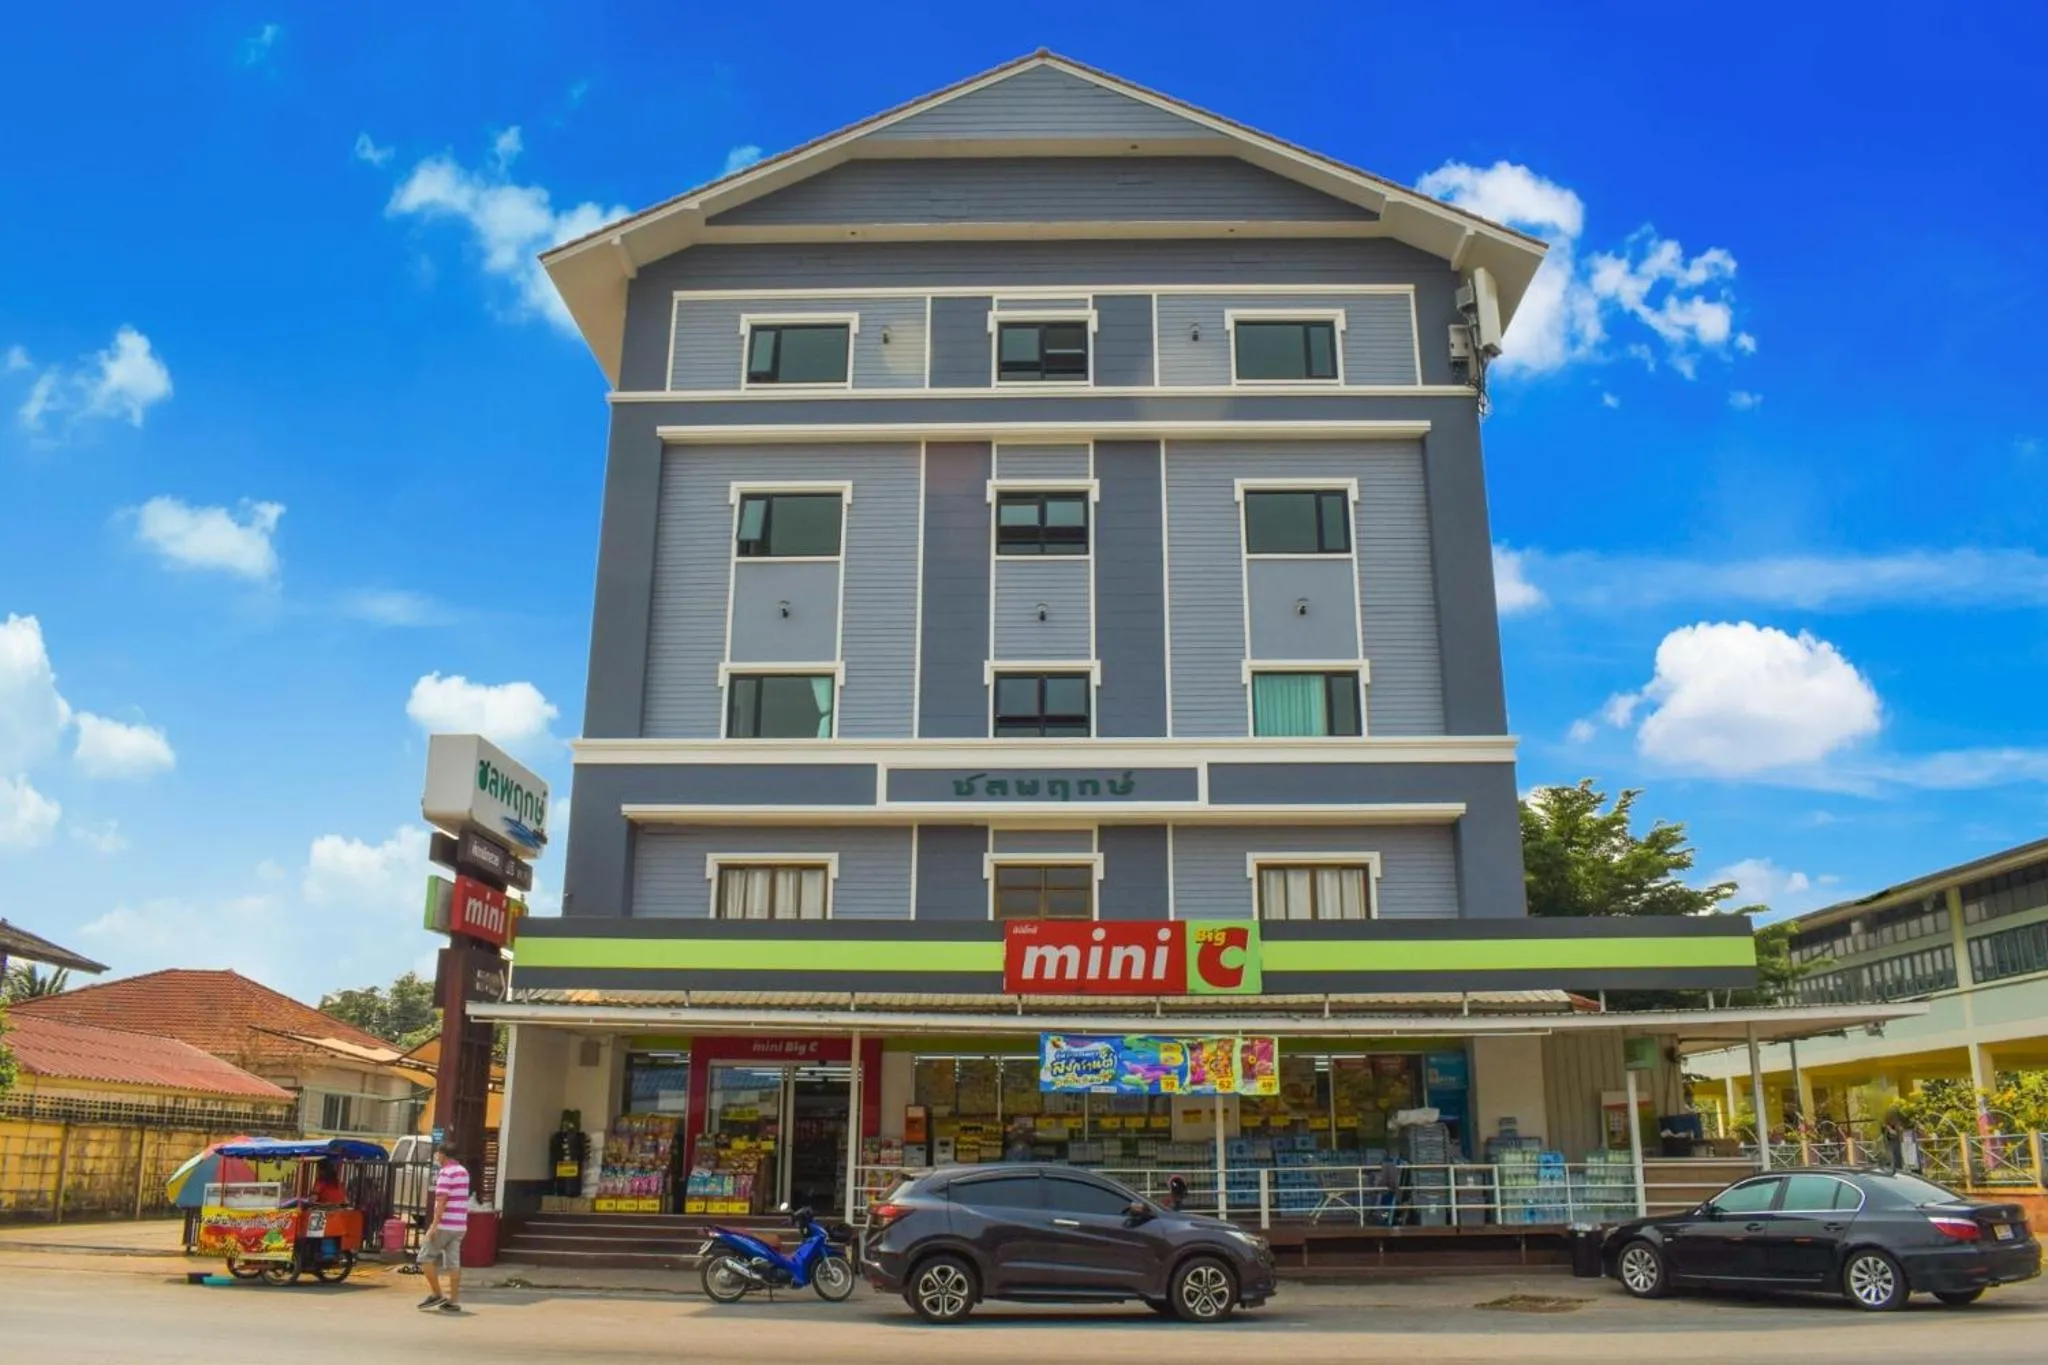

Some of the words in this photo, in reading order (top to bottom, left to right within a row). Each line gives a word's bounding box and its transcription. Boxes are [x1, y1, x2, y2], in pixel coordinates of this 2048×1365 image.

[478, 759, 548, 827] ชลพฤกษ์
[952, 771, 1136, 802] ชลพฤกษ์
[465, 891, 507, 935] mini
[1021, 927, 1171, 981] mini
[1195, 928, 1227, 946] Big
[1197, 926, 1250, 989] C
[753, 1040, 783, 1053] mini
[785, 1041, 807, 1056] Big
[808, 1041, 818, 1053] C
